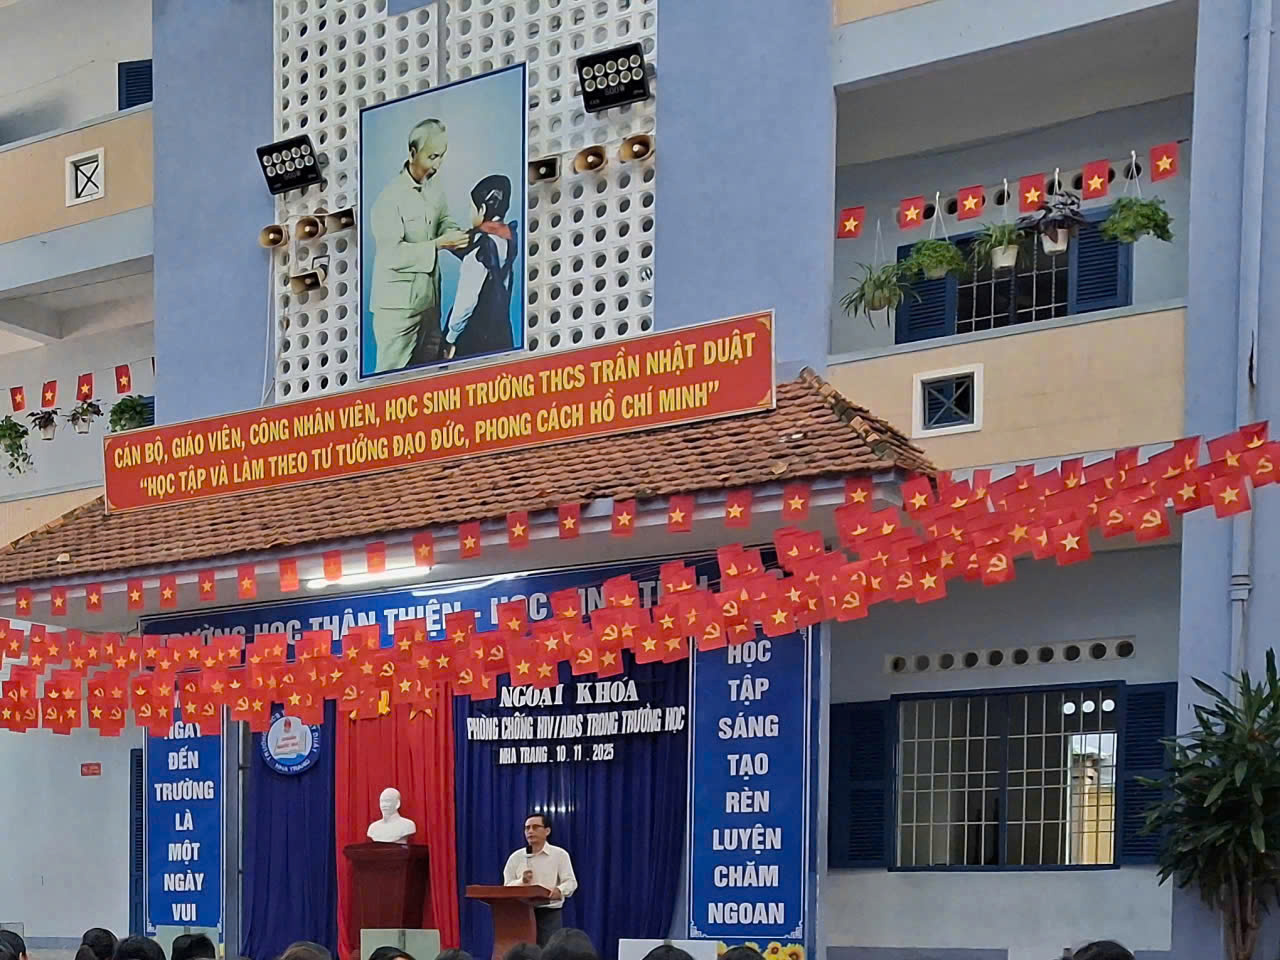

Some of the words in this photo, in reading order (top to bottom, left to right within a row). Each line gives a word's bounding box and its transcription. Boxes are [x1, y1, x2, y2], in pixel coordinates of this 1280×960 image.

[114, 444, 141, 468] CÁN
[145, 436, 168, 464] BỘ,
[172, 430, 204, 459] GIÁO
[208, 423, 246, 452] VIÊN,
[249, 416, 289, 445] CÔNG
[293, 407, 334, 438] NHÂN
[339, 400, 380, 430] VIÊN,
[385, 395, 419, 424] HỌC
[423, 387, 461, 415] SINH
[466, 373, 535, 405] TRƯỜNG
[539, 364, 585, 393] THCS
[590, 347, 640, 383] TRẦN
[646, 341, 696, 378] NHẬT
[703, 329, 756, 367] DUẬT
[179, 464, 206, 492] TẬP
[210, 459, 228, 486] VÀ
[233, 454, 264, 483] LÀM
[268, 453, 308, 476] THEO
[312, 446, 334, 470] TƯ
[336, 433, 389, 466] TƯỞNG
[393, 431, 426, 460] ĐẠO
[430, 419, 470, 450] ĐỨC,
[475, 412, 531, 444] PHONG
[536, 402, 584, 432] CÁCH
[590, 388, 615, 423] HỒ
[621, 386, 652, 419] CHÍ
[727, 639, 771, 667] HỌC
[499, 684, 564, 708] NGOẠI
[728, 674, 769, 705] TẬP
[467, 714, 499, 740] PHÒNG
[501, 711, 534, 740] CHỐNG
[537, 714, 583, 739] HIV/AIDS
[586, 711, 619, 737] TRONG
[622, 702, 662, 734] TRƯỜNG
[664, 705, 686, 734] HỌC
[718, 713, 779, 739] SÁNG
[168, 746, 199, 771] ĐẾN
[499, 747, 517, 764] NHA
[520, 745, 548, 764] TRANG
[592, 743, 614, 761] 2025
[727, 753, 769, 780] TẠO
[154, 778, 214, 801] TRƯỜNG
[725, 787, 770, 813] RÈN
[175, 809, 193, 831] LÀ
[713, 823, 782, 854] LUYỆN
[168, 840, 200, 865] MỘT
[164, 872, 204, 892] NGÀY
[714, 861, 779, 888] CHĂM
[172, 903, 196, 921] VUI
[708, 902, 785, 925] NGOAN
